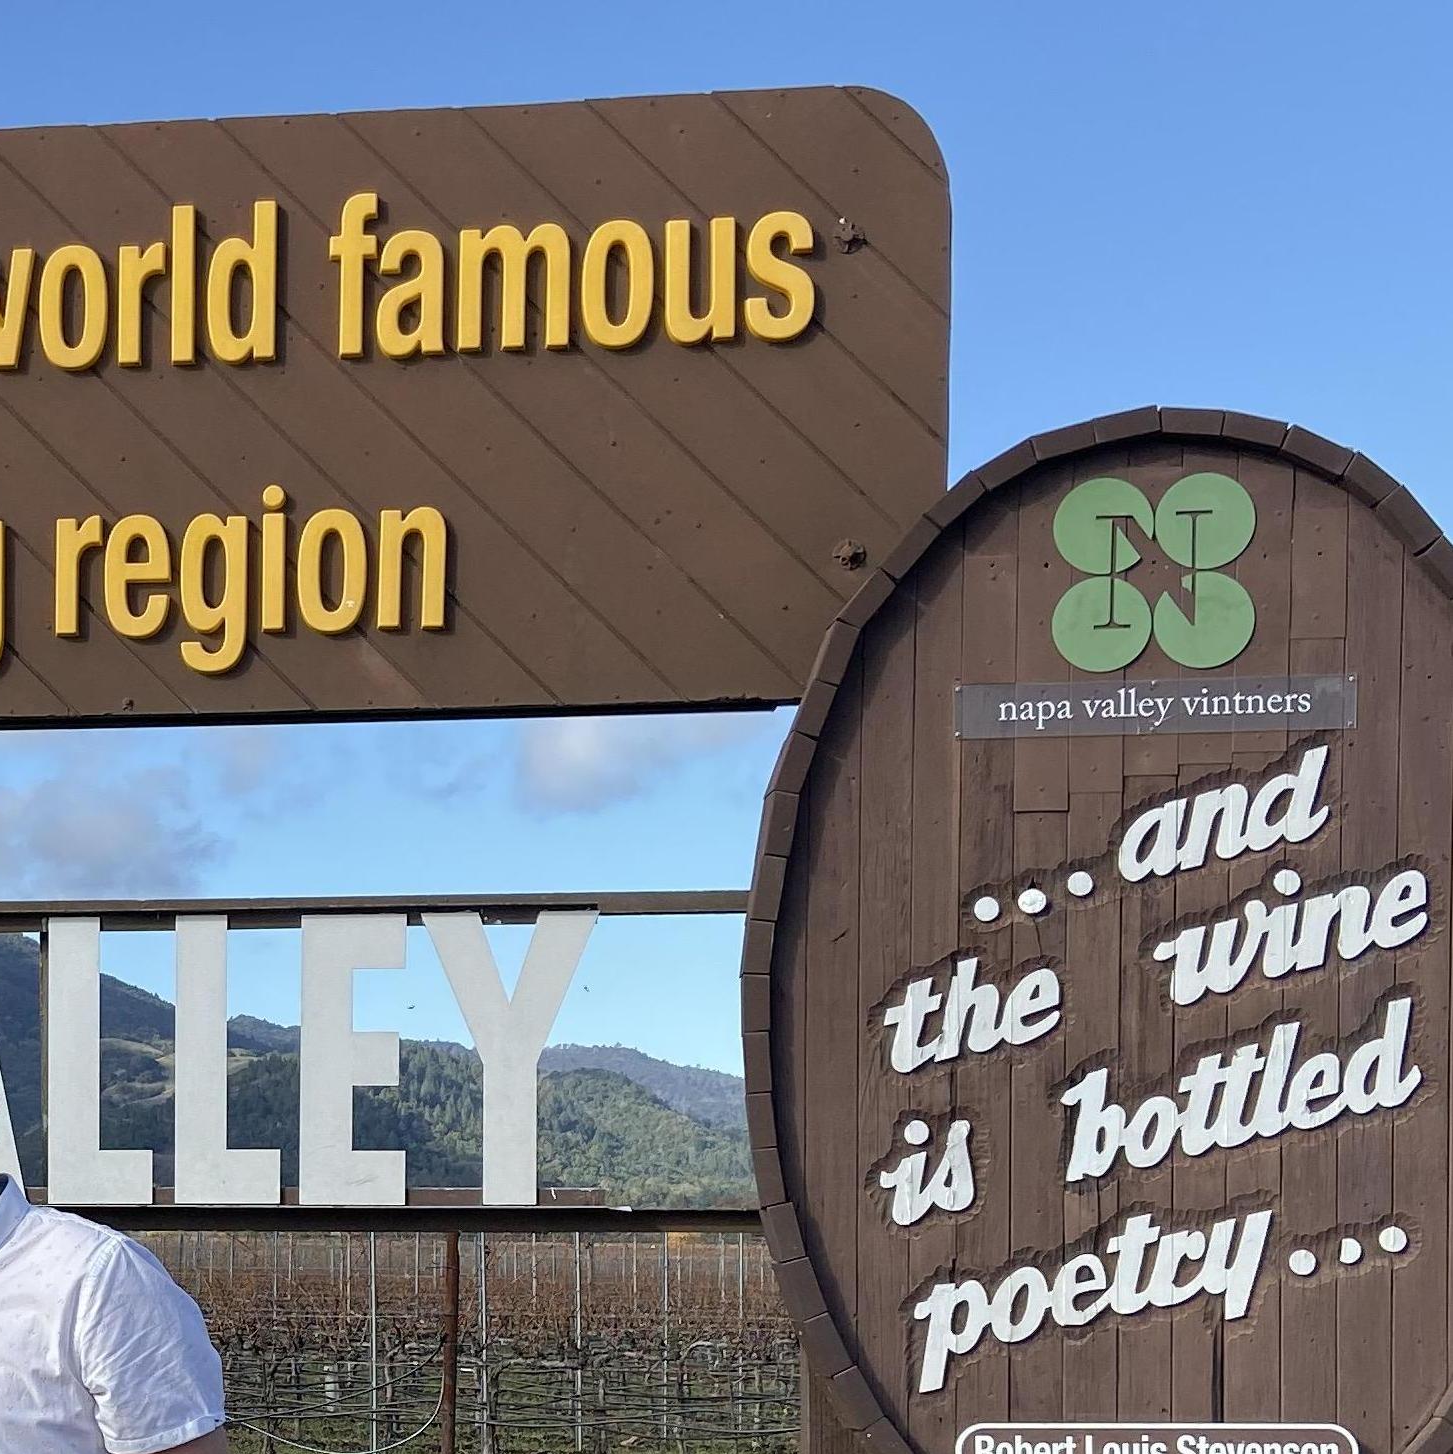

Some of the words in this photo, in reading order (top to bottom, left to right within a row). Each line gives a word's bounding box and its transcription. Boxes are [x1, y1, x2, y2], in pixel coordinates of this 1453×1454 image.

[328, 191, 817, 362] famous
[54, 484, 448, 677] region
[997, 692, 1075, 732] napa
[1081, 687, 1176, 726] valley
[1181, 685, 1313, 719] vintners
[882, 957, 1062, 1075] the
[1152, 867, 1429, 1006] wine
[879, 1119, 974, 1226] is
[1060, 996, 1422, 1183] bottled
